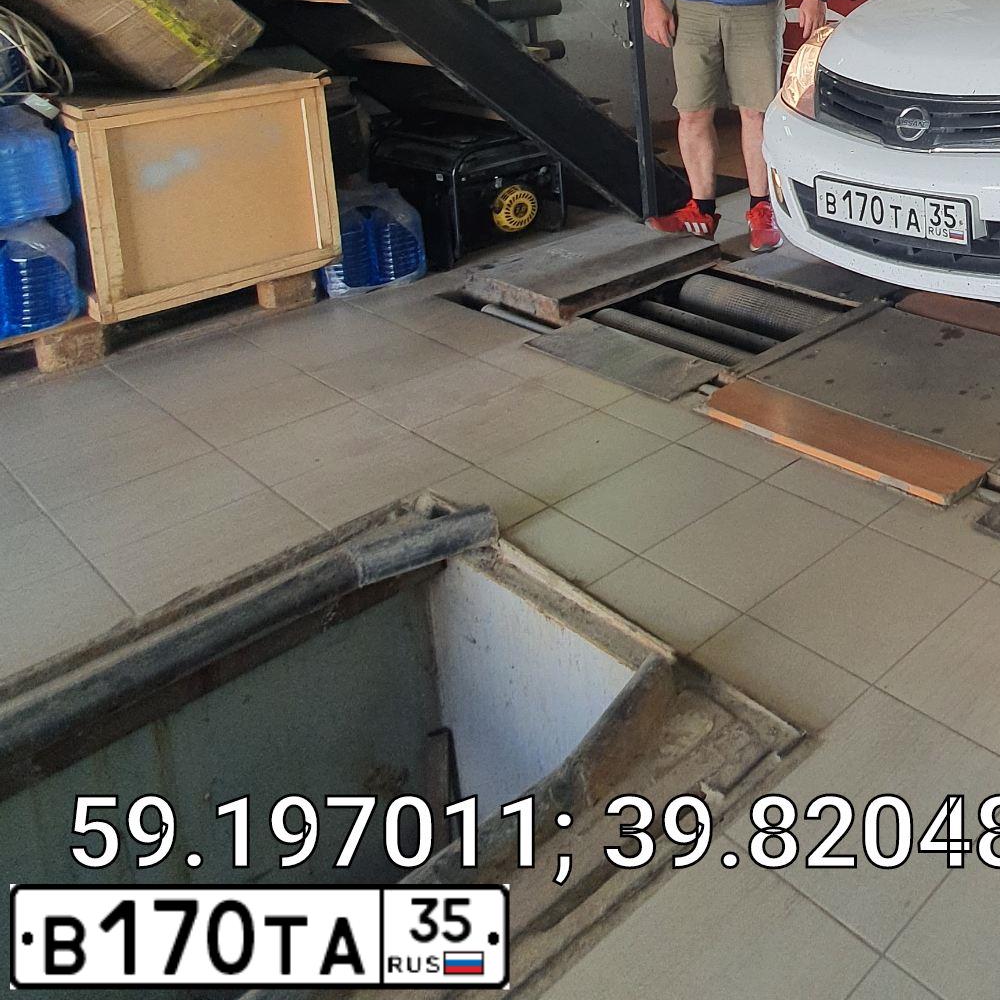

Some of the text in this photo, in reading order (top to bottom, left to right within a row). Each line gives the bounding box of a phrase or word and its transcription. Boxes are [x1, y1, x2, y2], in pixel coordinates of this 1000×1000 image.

[825, 190, 956, 233] В170ТА 35
[928, 226, 948, 237] RUS
